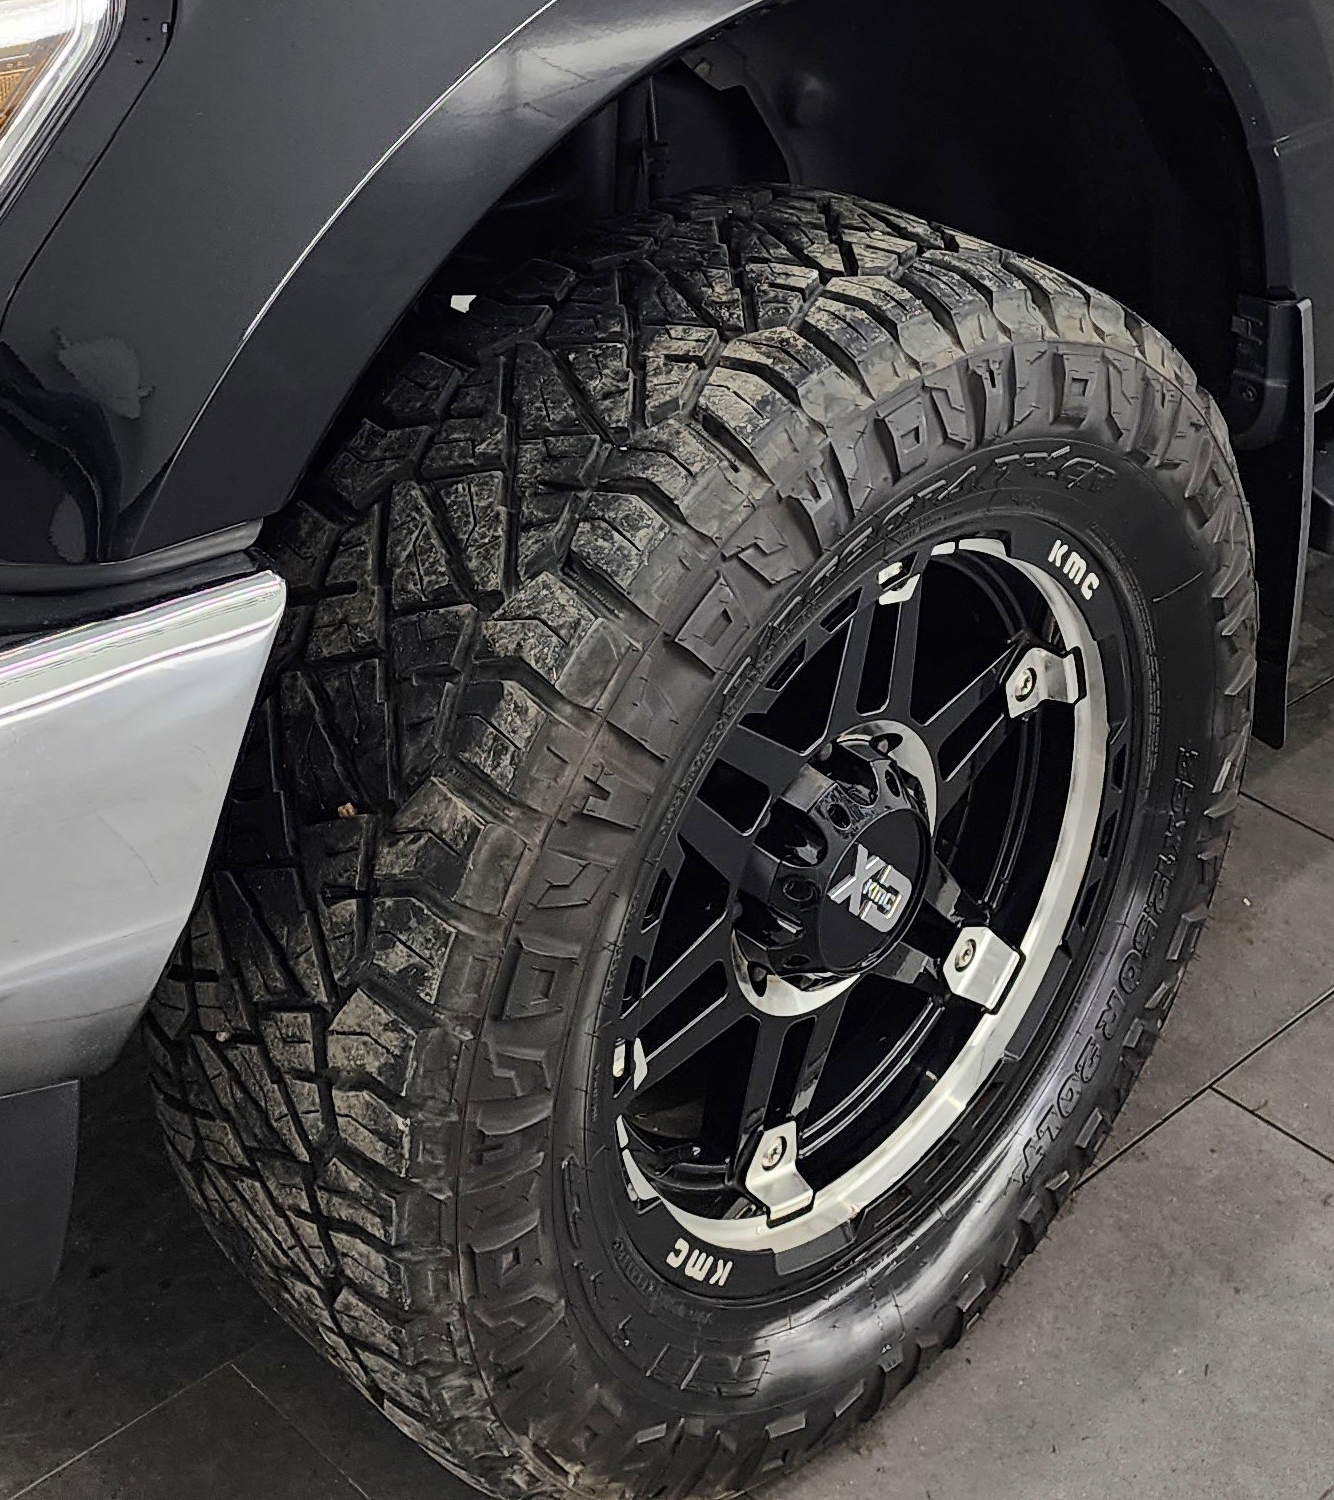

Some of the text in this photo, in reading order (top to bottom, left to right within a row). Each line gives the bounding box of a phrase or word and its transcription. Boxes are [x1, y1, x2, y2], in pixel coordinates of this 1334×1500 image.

[1047, 539, 1101, 601] KMC
[827, 842, 912, 932] XD
[666, 1238, 733, 1286] KMC
